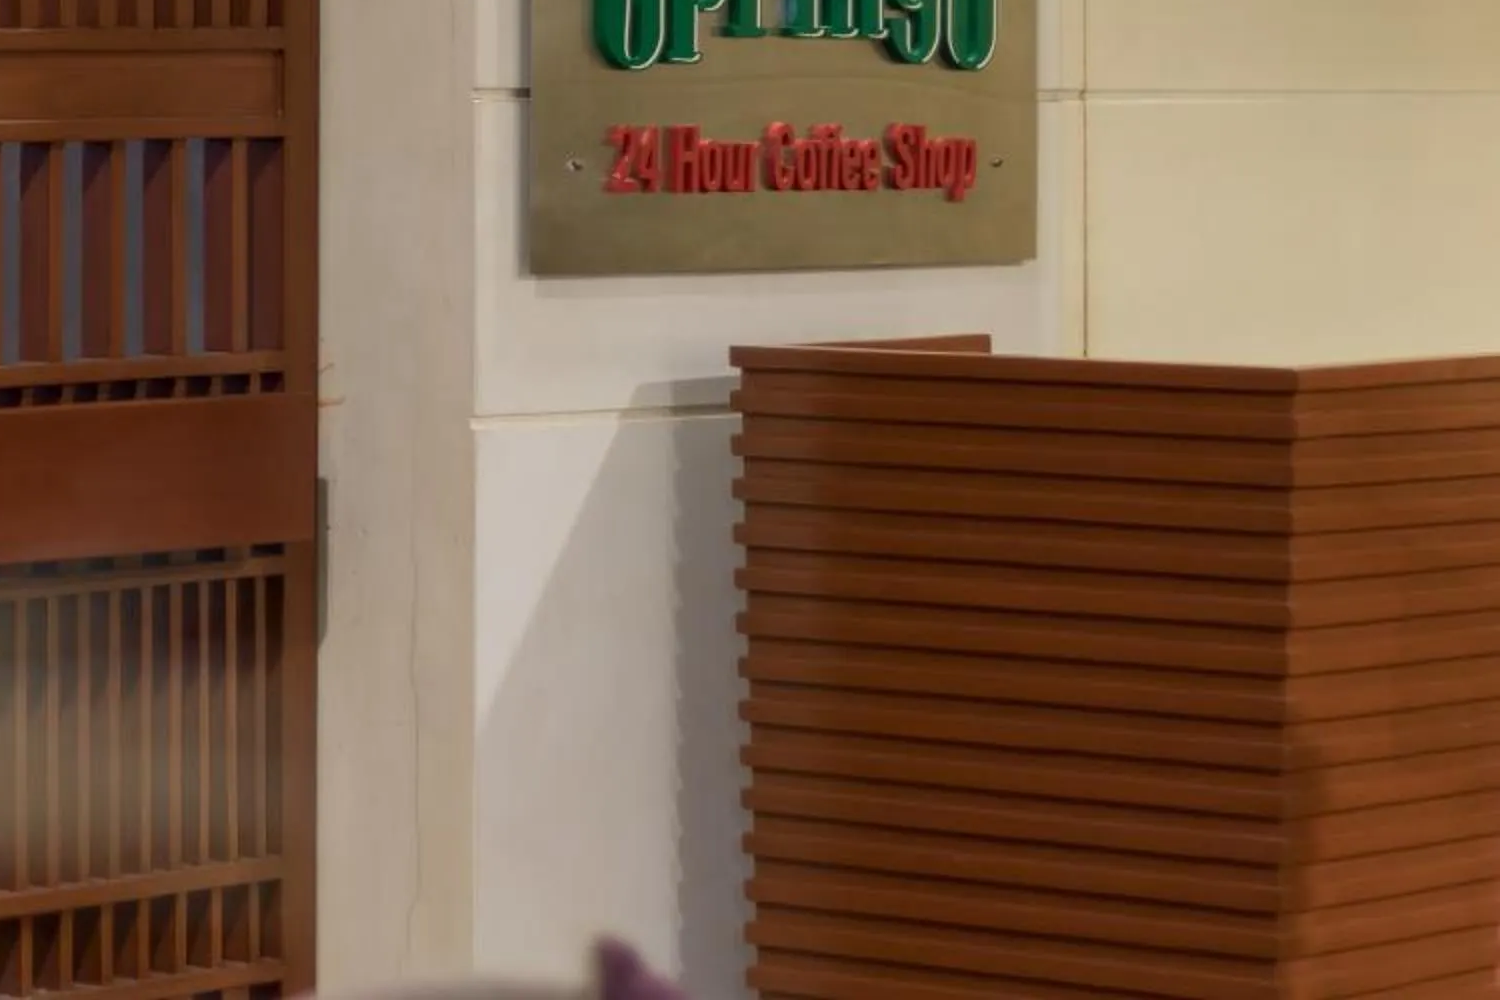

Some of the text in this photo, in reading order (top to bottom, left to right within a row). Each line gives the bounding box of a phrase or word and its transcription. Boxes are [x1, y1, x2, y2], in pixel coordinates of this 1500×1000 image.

[605, 121, 978, 201] 24 Hour Coffee Shop
